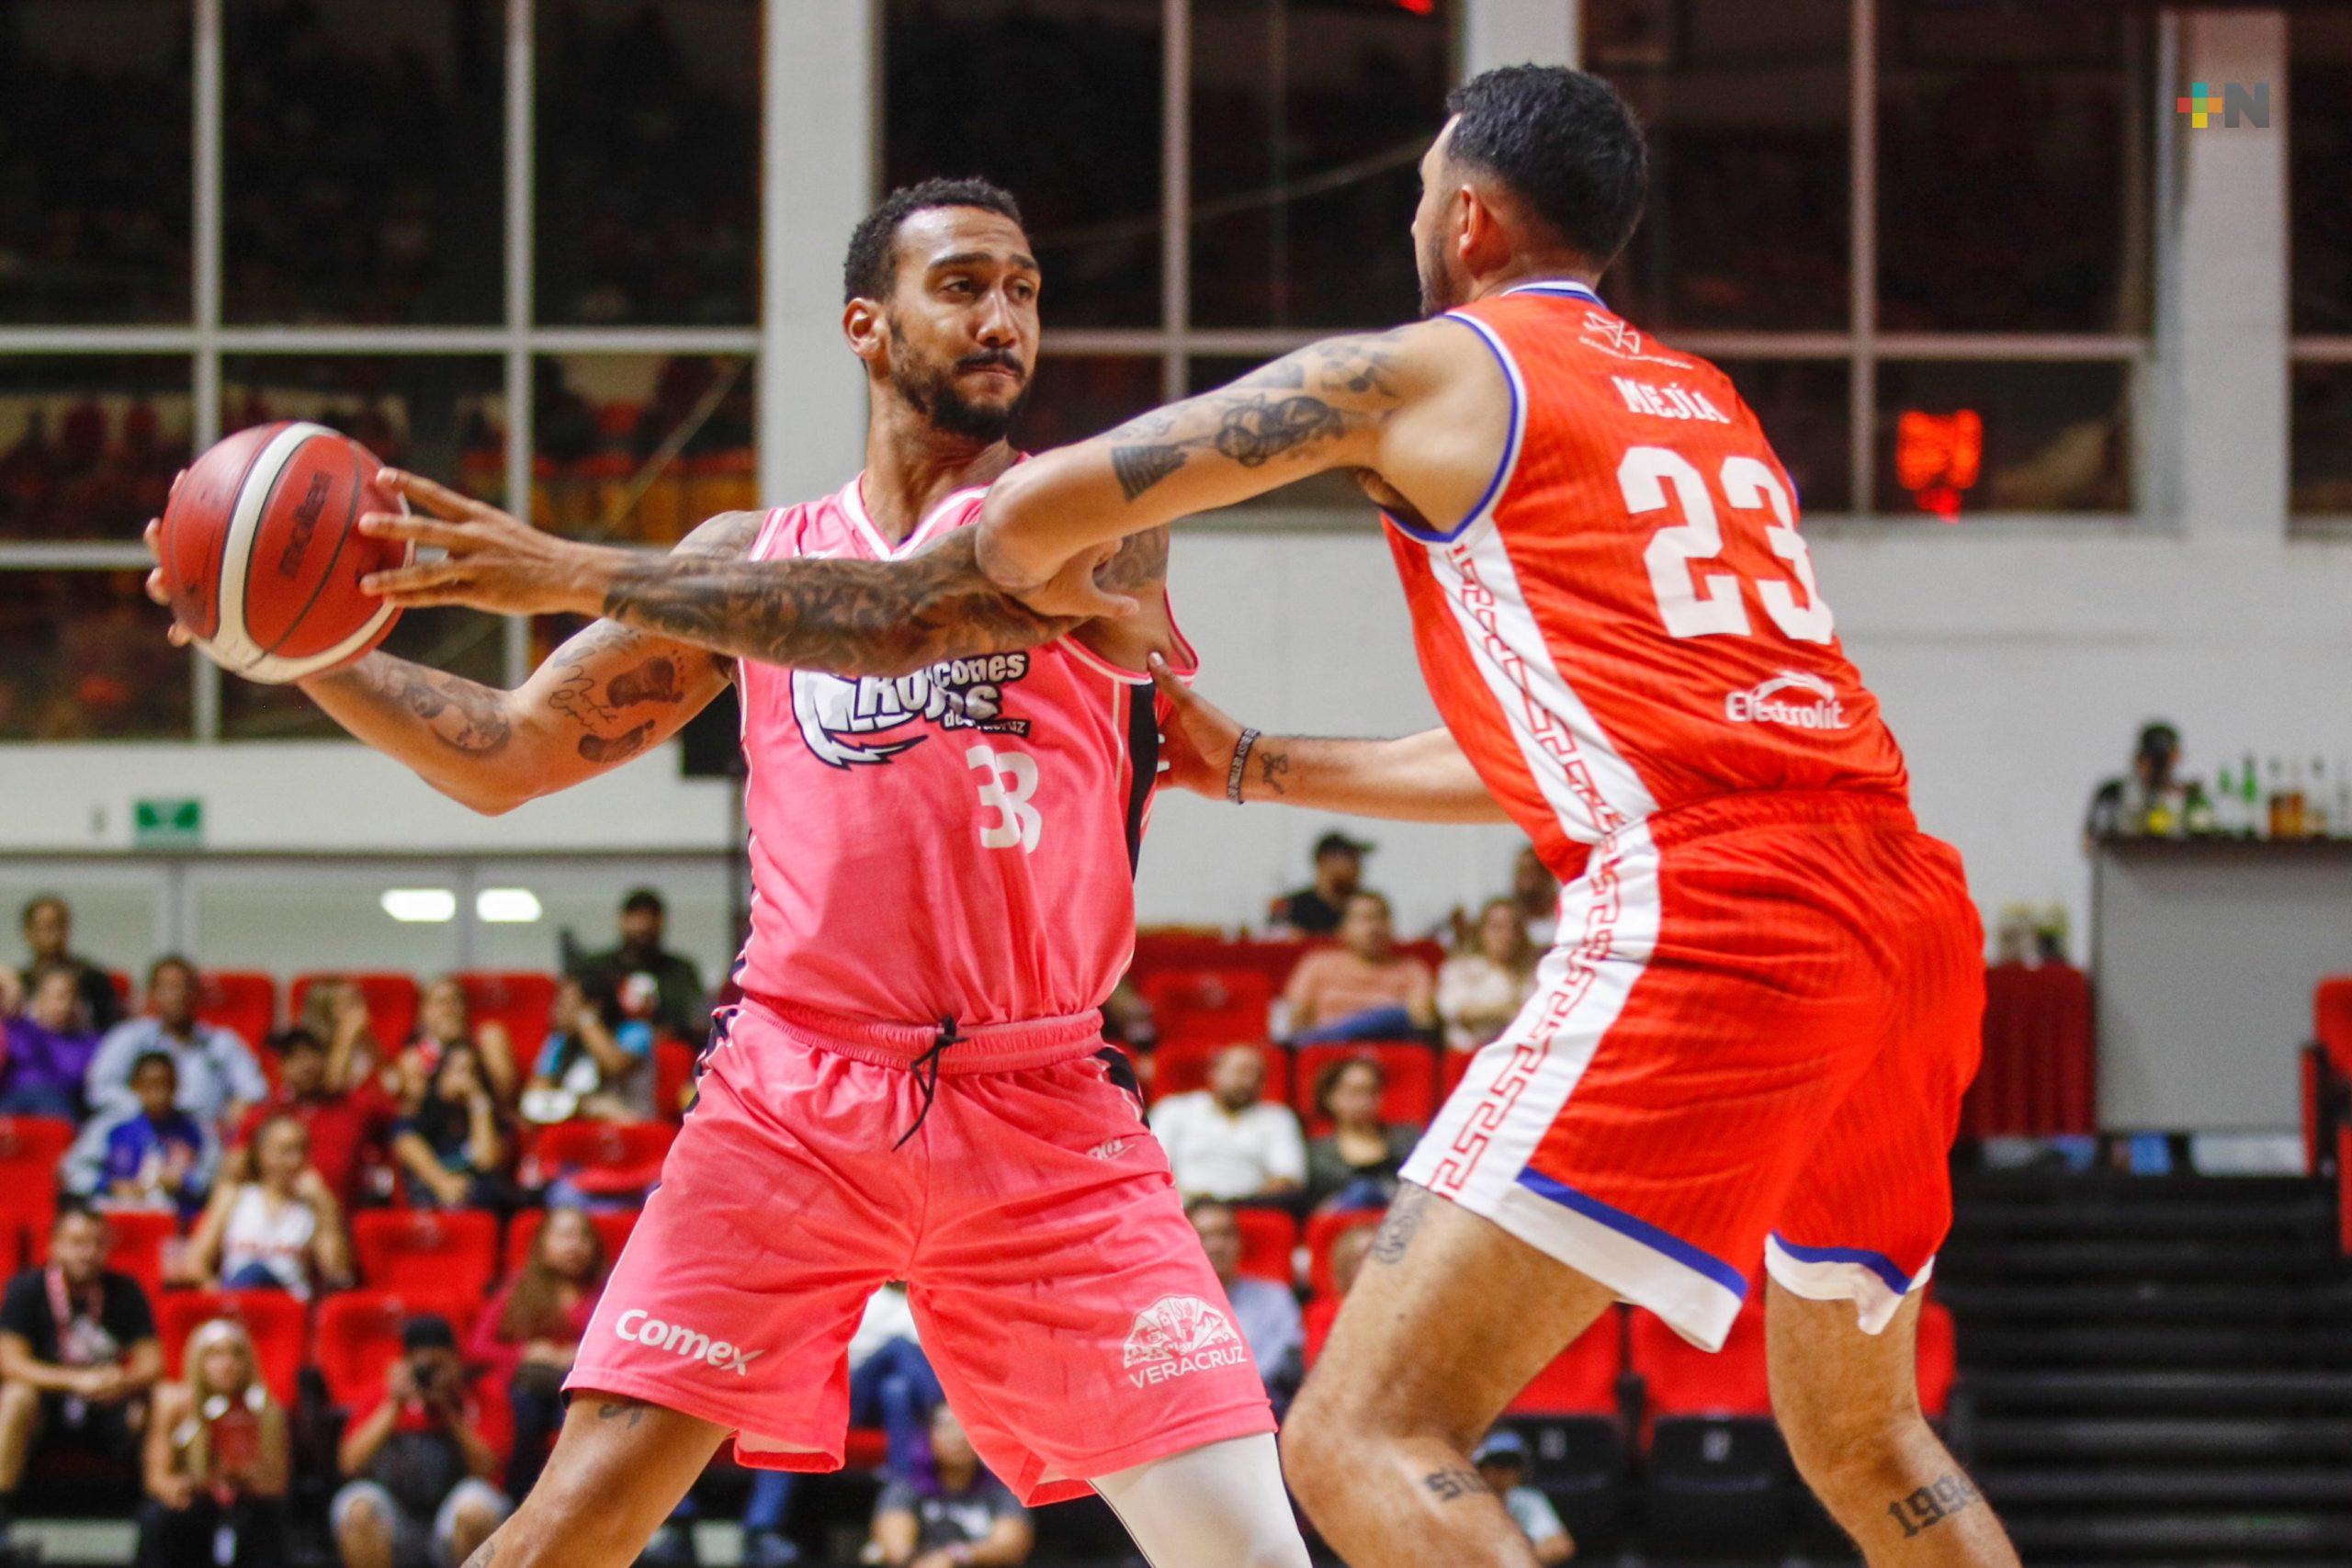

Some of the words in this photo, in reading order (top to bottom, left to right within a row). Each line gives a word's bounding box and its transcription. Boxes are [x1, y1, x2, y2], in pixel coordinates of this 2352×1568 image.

[1617, 446, 1835, 645] 23
[966, 745, 1043, 854] 33
[616, 1308, 765, 1376] Comex
[1128, 1346, 1248, 1389] VERACRUZ
